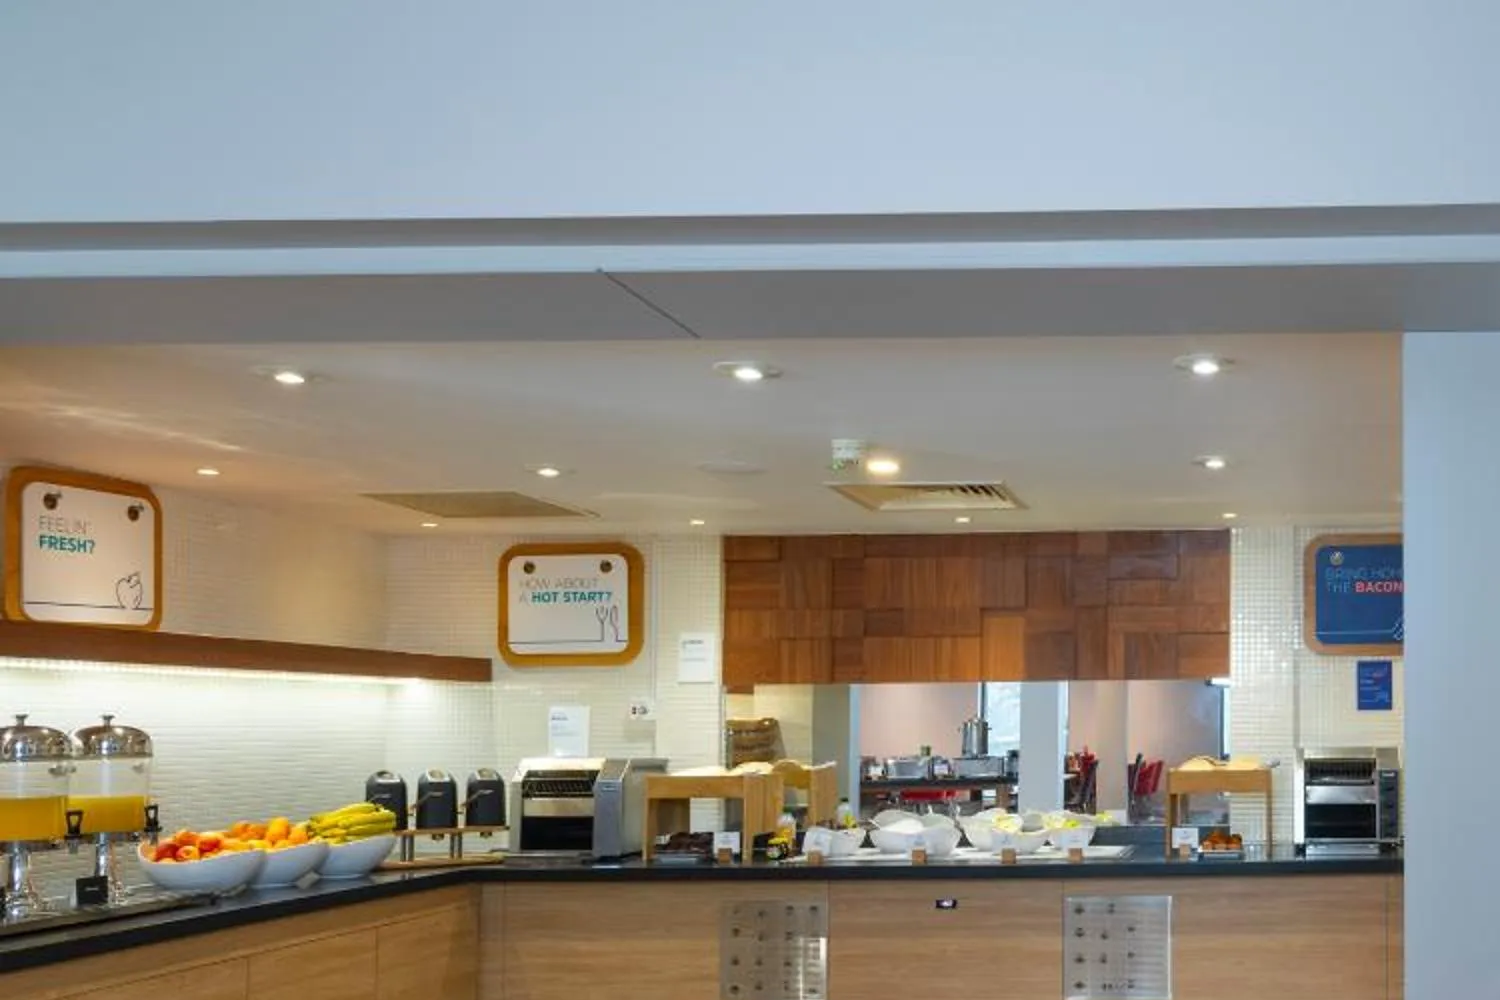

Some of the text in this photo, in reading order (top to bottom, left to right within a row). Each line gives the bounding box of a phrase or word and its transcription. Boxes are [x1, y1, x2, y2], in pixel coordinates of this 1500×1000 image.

[39, 535, 95, 554] FRESH?
[1371, 567, 1404, 579] HOM
[519, 578, 598, 589] HOW ABOUT
[1327, 581, 1351, 593] THE
[531, 591, 559, 602] HOT
[563, 591, 613, 602] START?
